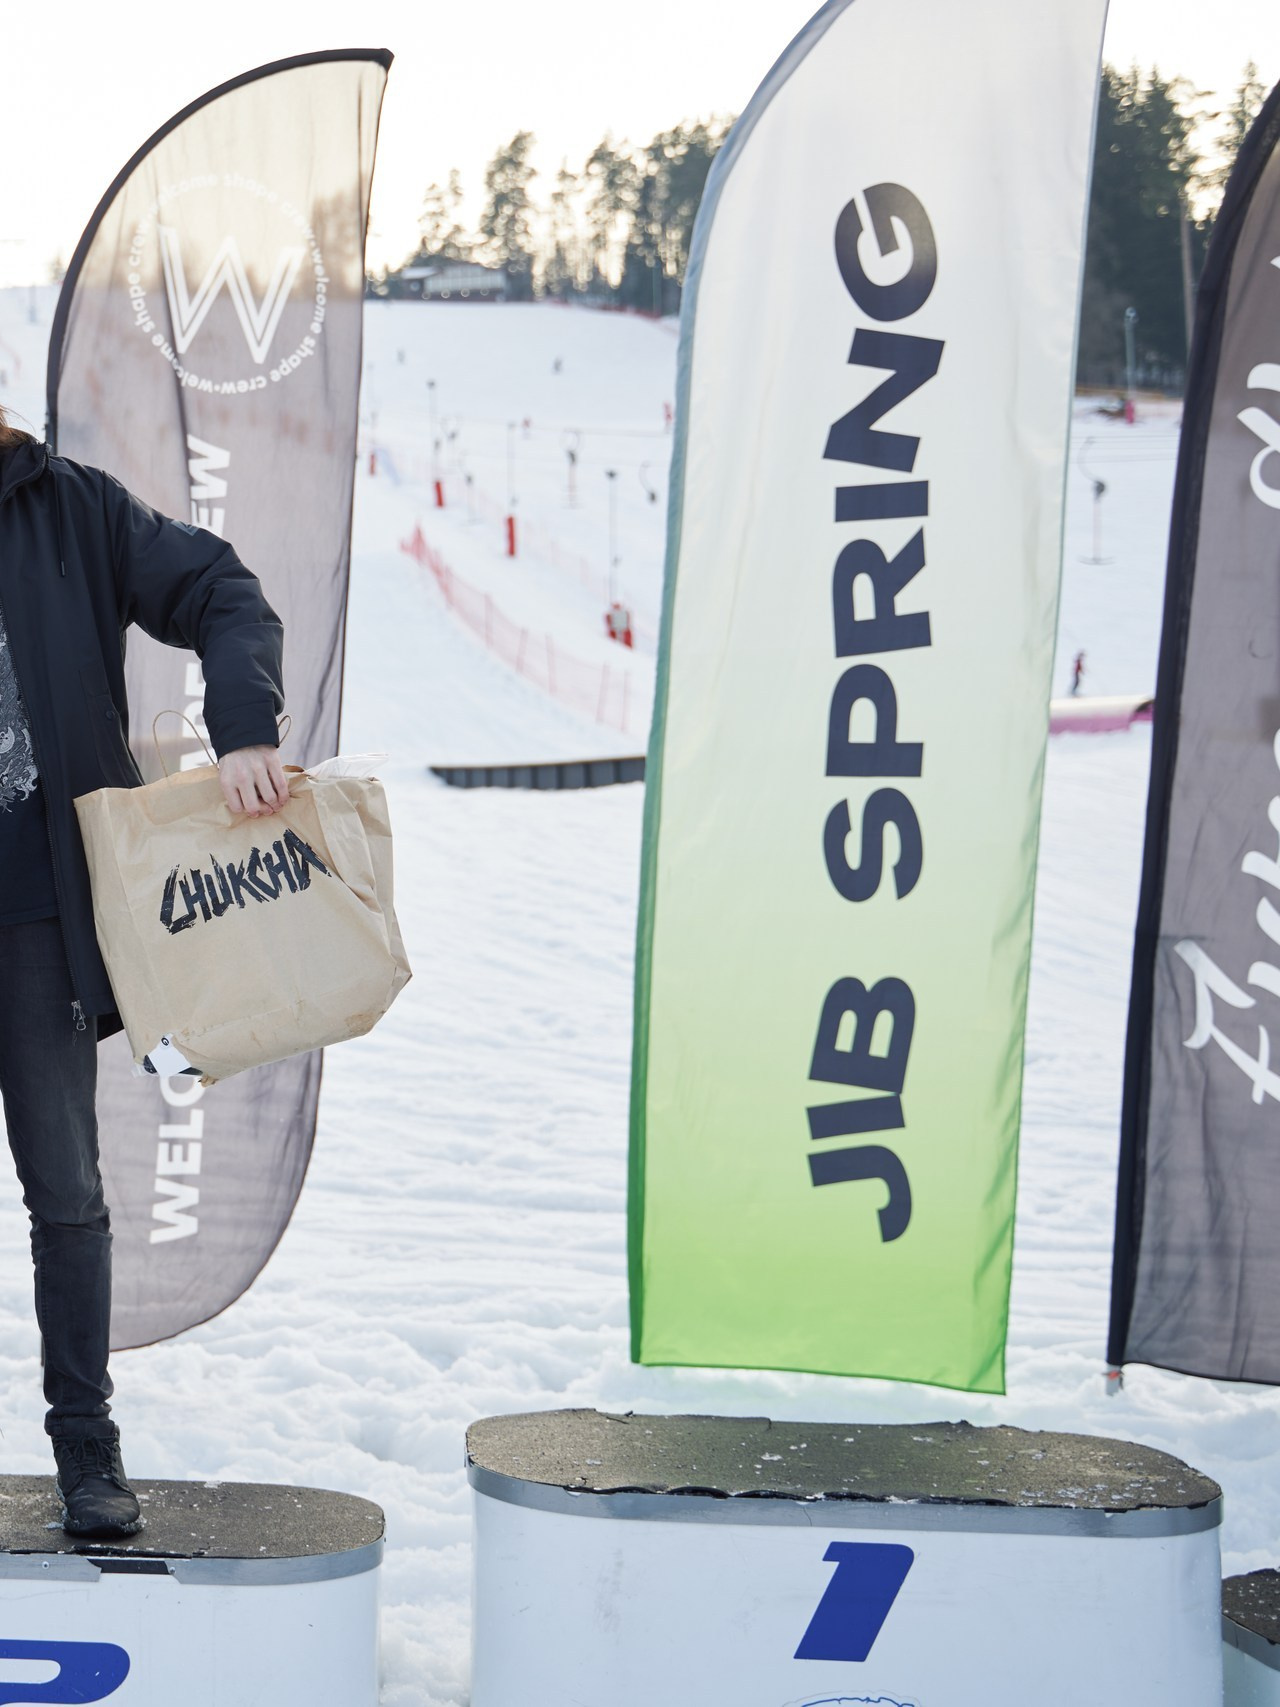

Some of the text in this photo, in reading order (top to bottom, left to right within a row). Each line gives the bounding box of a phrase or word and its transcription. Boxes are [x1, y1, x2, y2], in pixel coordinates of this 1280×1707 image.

[223, 172, 278, 203] shape
[129, 219, 151, 267] crew
[280, 201, 315, 240] crew
[128, 272, 156, 334] shape
[312, 248, 330, 334] welcome
[221, 374, 268, 395] crew
[269, 335, 316, 383] shape
[806, 182, 946, 1243] JIB SPRING
[160, 828, 333, 935] CHUKCHA
[793, 1541, 916, 1663] 1
